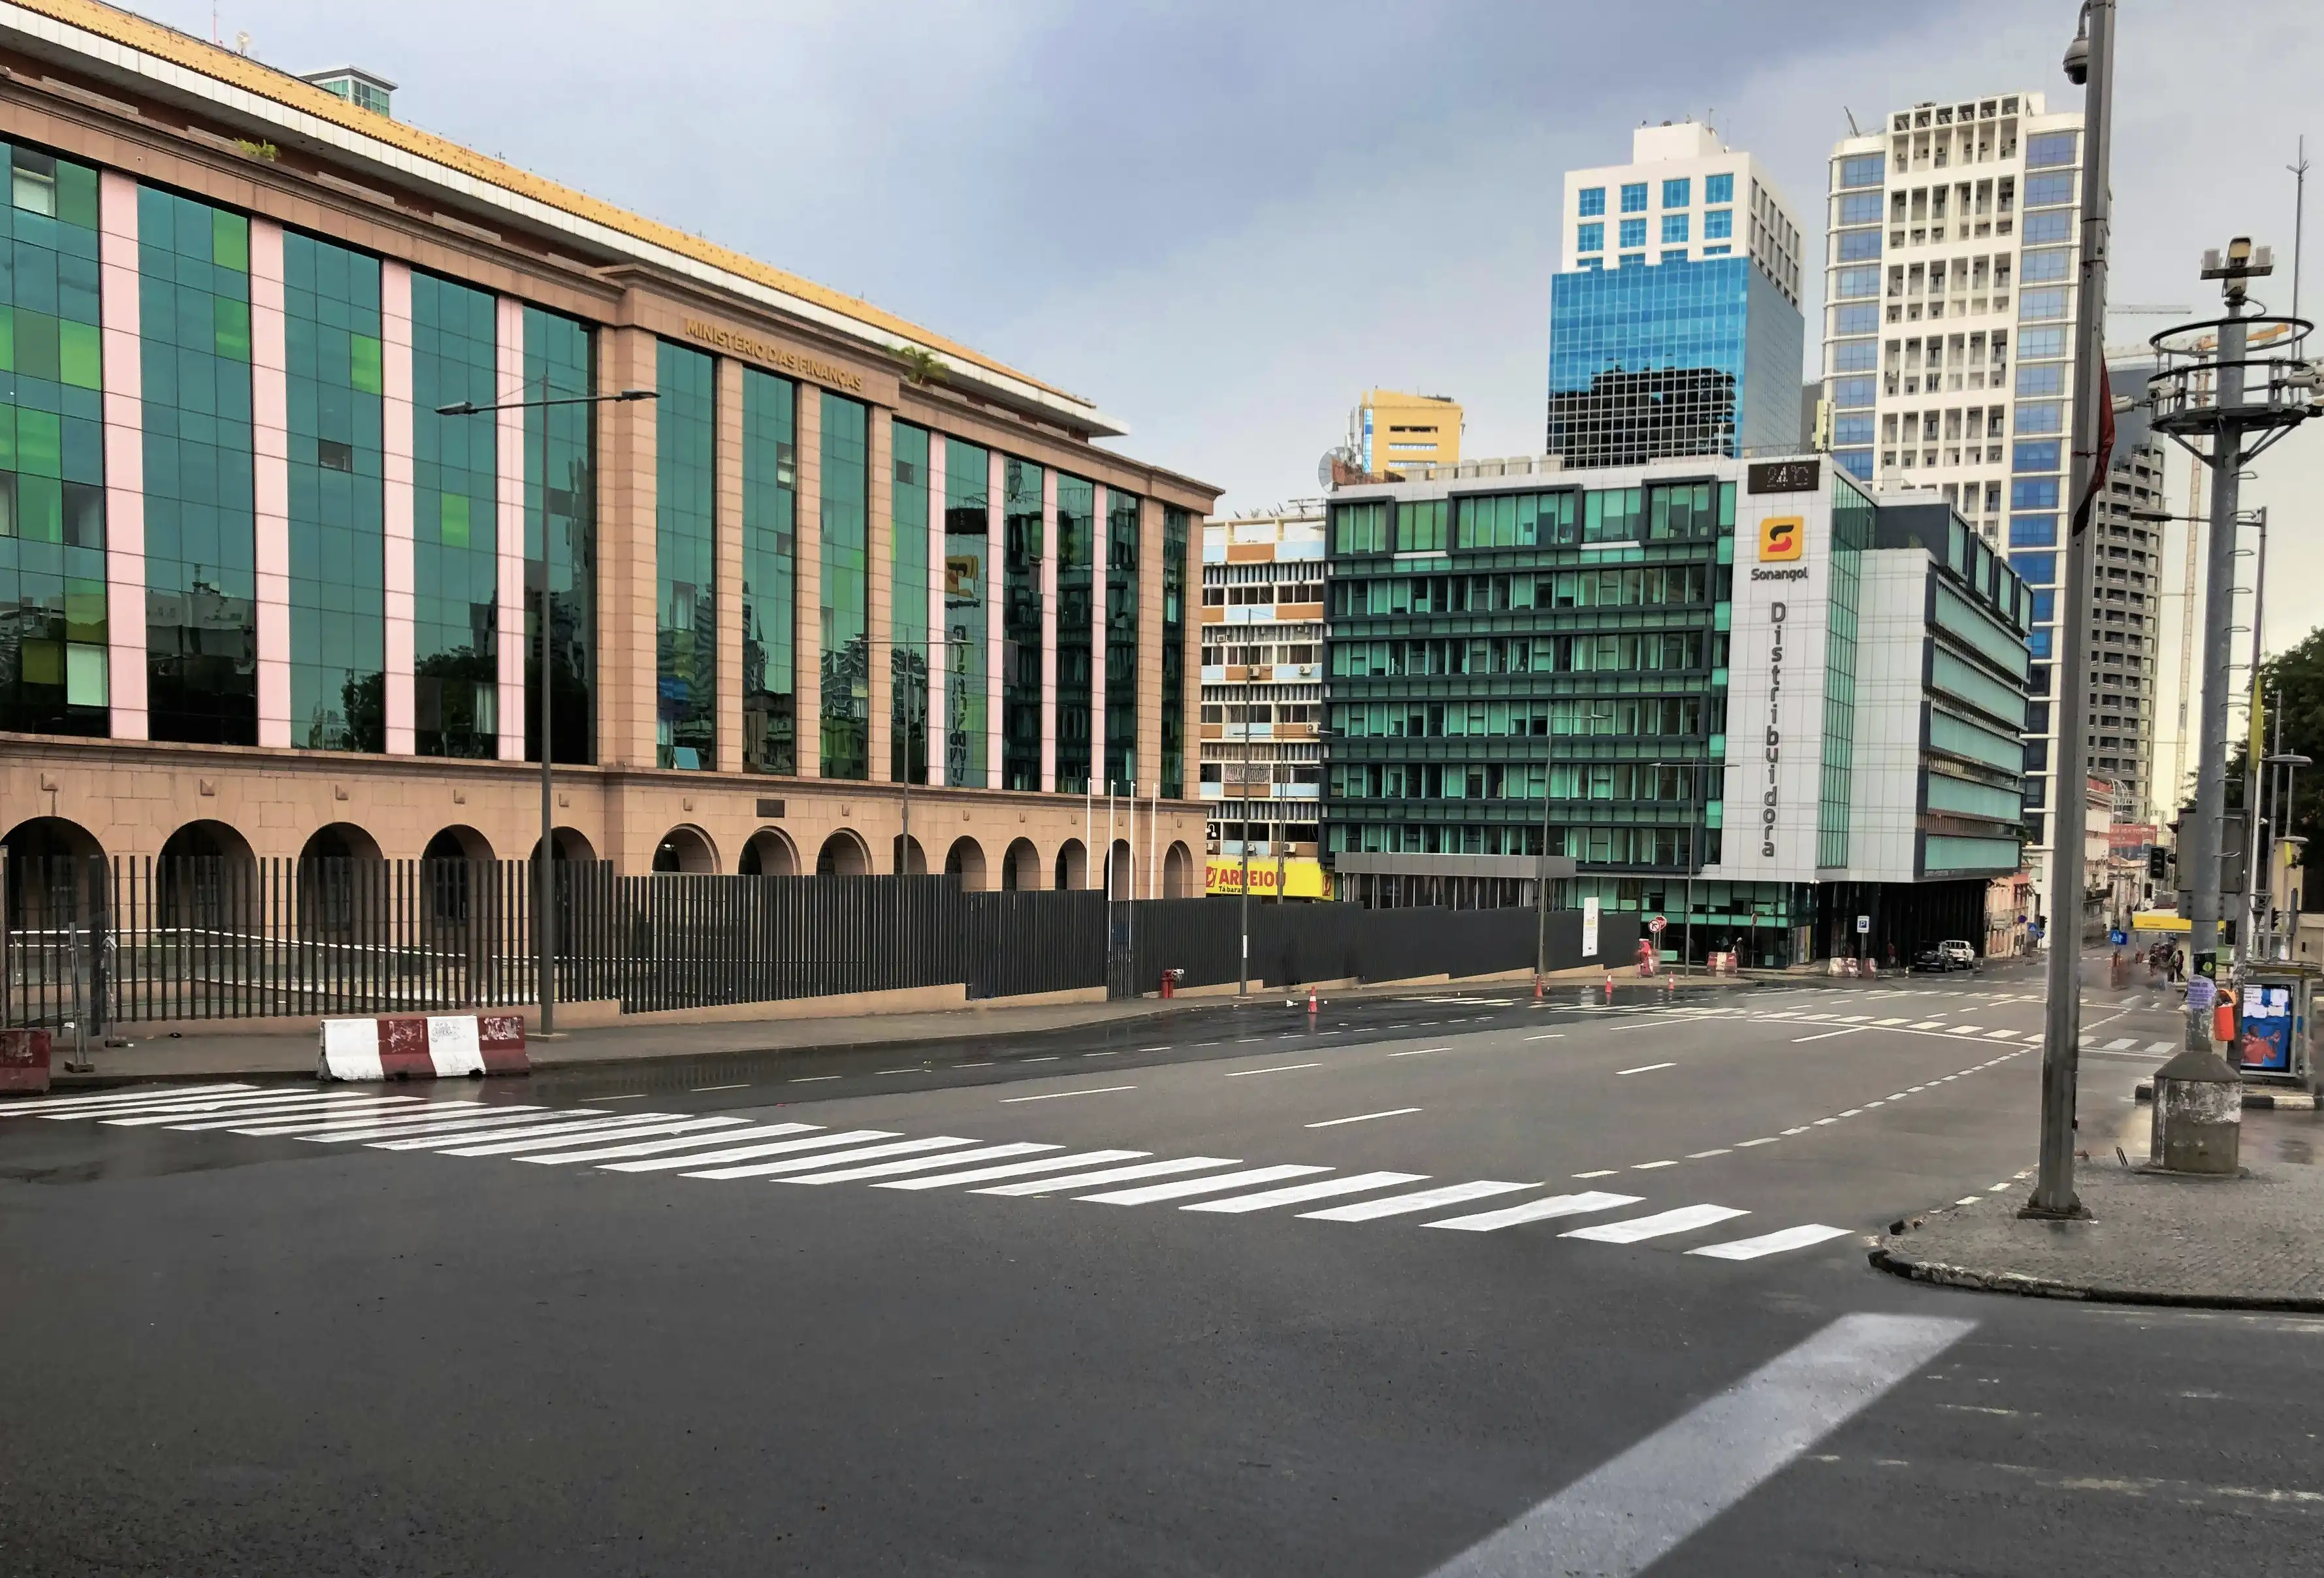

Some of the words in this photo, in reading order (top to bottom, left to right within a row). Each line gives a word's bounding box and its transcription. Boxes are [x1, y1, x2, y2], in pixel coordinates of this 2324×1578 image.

[685, 317, 764, 359] MINISTÉRIO
[766, 345, 796, 370] DAS
[798, 356, 863, 392] FINANÇAS
[1751, 566, 1809, 583] Sonangol
[1762, 602, 1786, 857] Distribuidora
